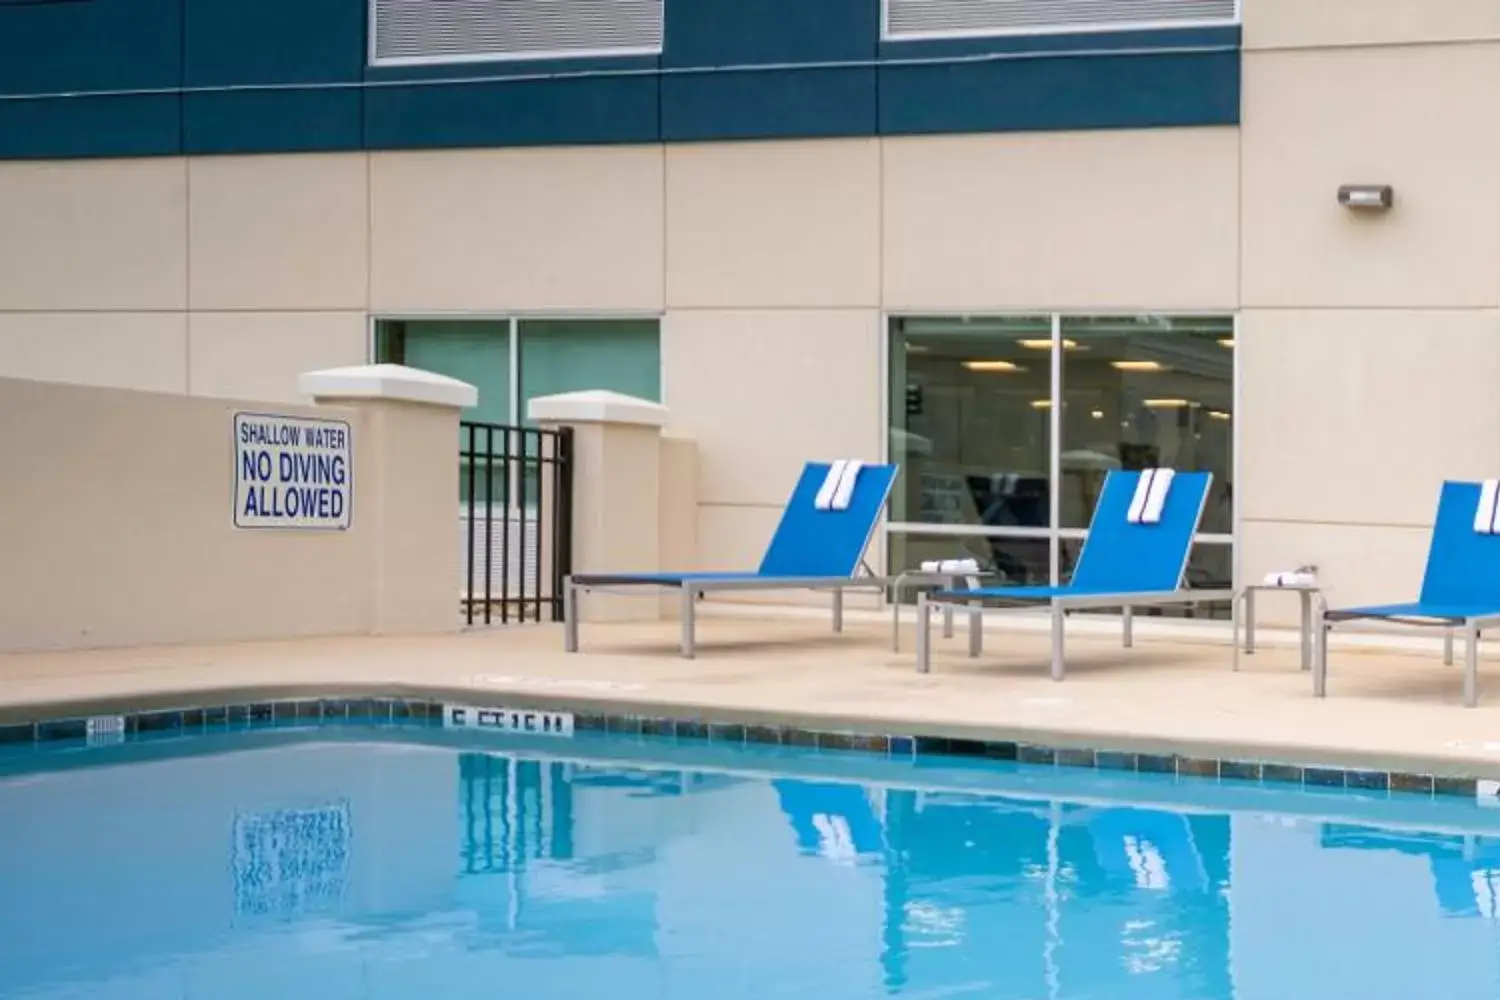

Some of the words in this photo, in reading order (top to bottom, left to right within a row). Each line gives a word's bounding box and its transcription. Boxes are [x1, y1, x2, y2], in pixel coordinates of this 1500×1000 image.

[241, 422, 300, 446] SHALLOW
[305, 427, 345, 449] WATER
[243, 450, 272, 482] NO
[280, 452, 345, 485] DIVING
[244, 486, 343, 519] ALLOWED
